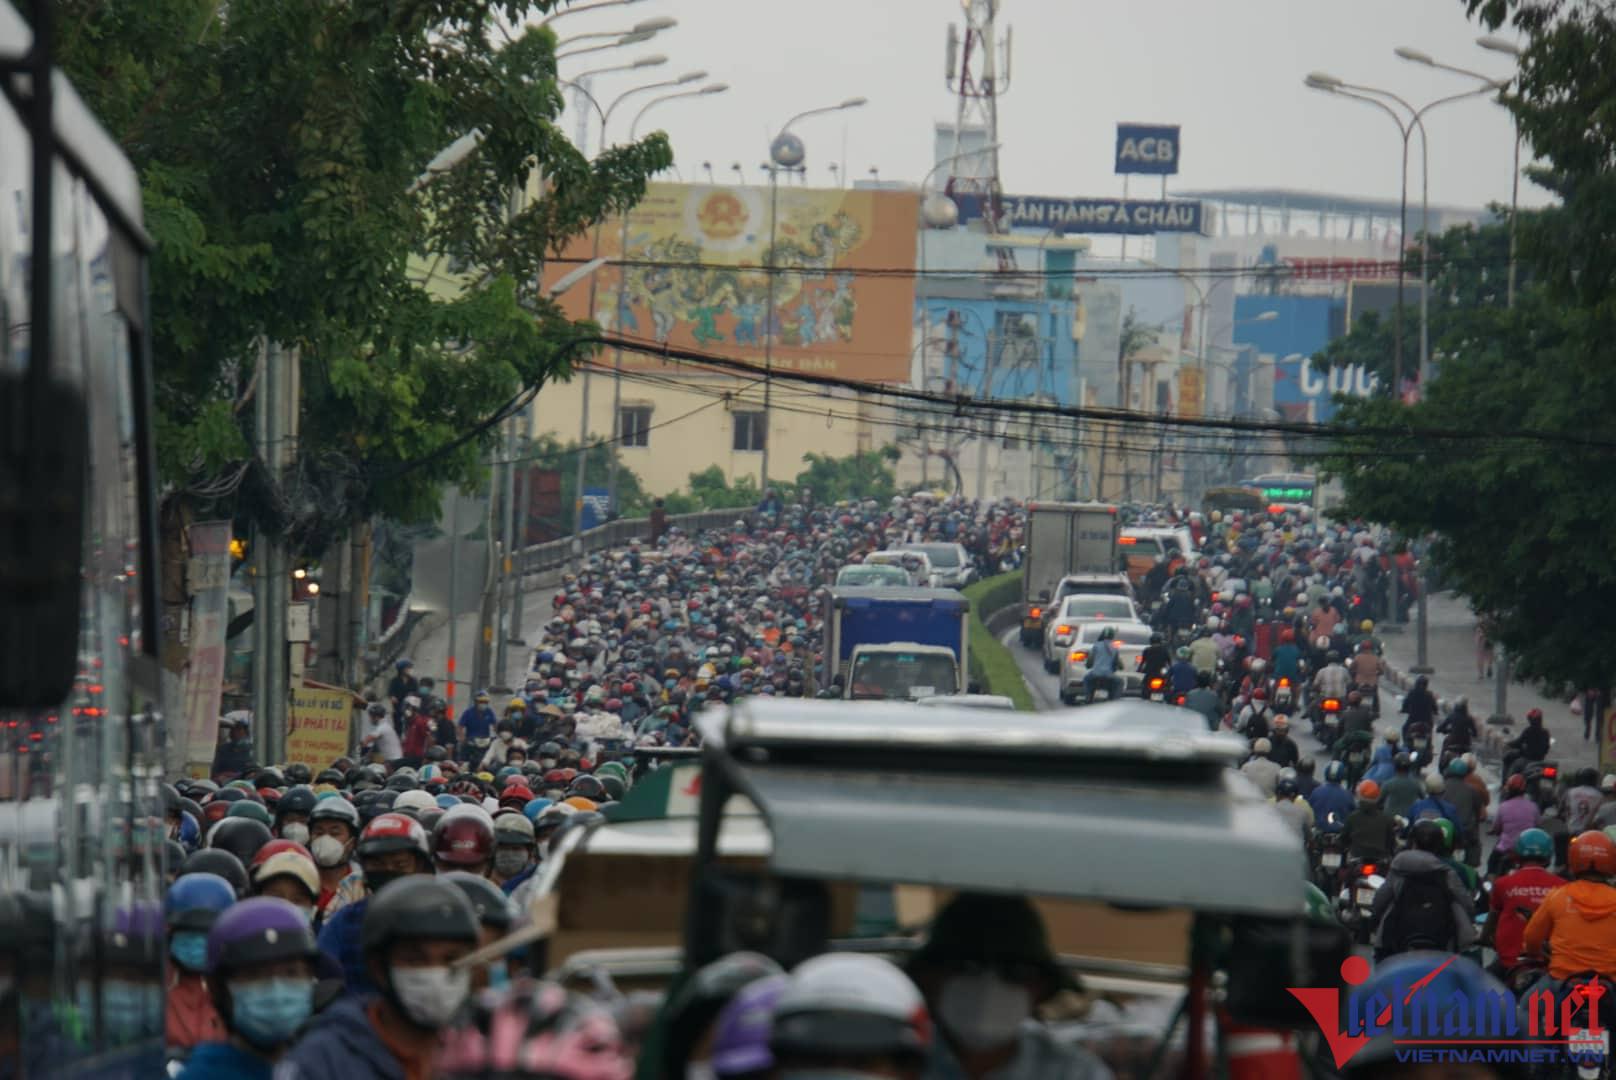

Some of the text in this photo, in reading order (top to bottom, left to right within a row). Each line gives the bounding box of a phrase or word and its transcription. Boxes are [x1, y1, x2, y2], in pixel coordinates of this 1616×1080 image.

[1119, 136, 1174, 161] ACB
[1133, 202, 1193, 225] CHÂU
[1505, 886, 1553, 897] viette
